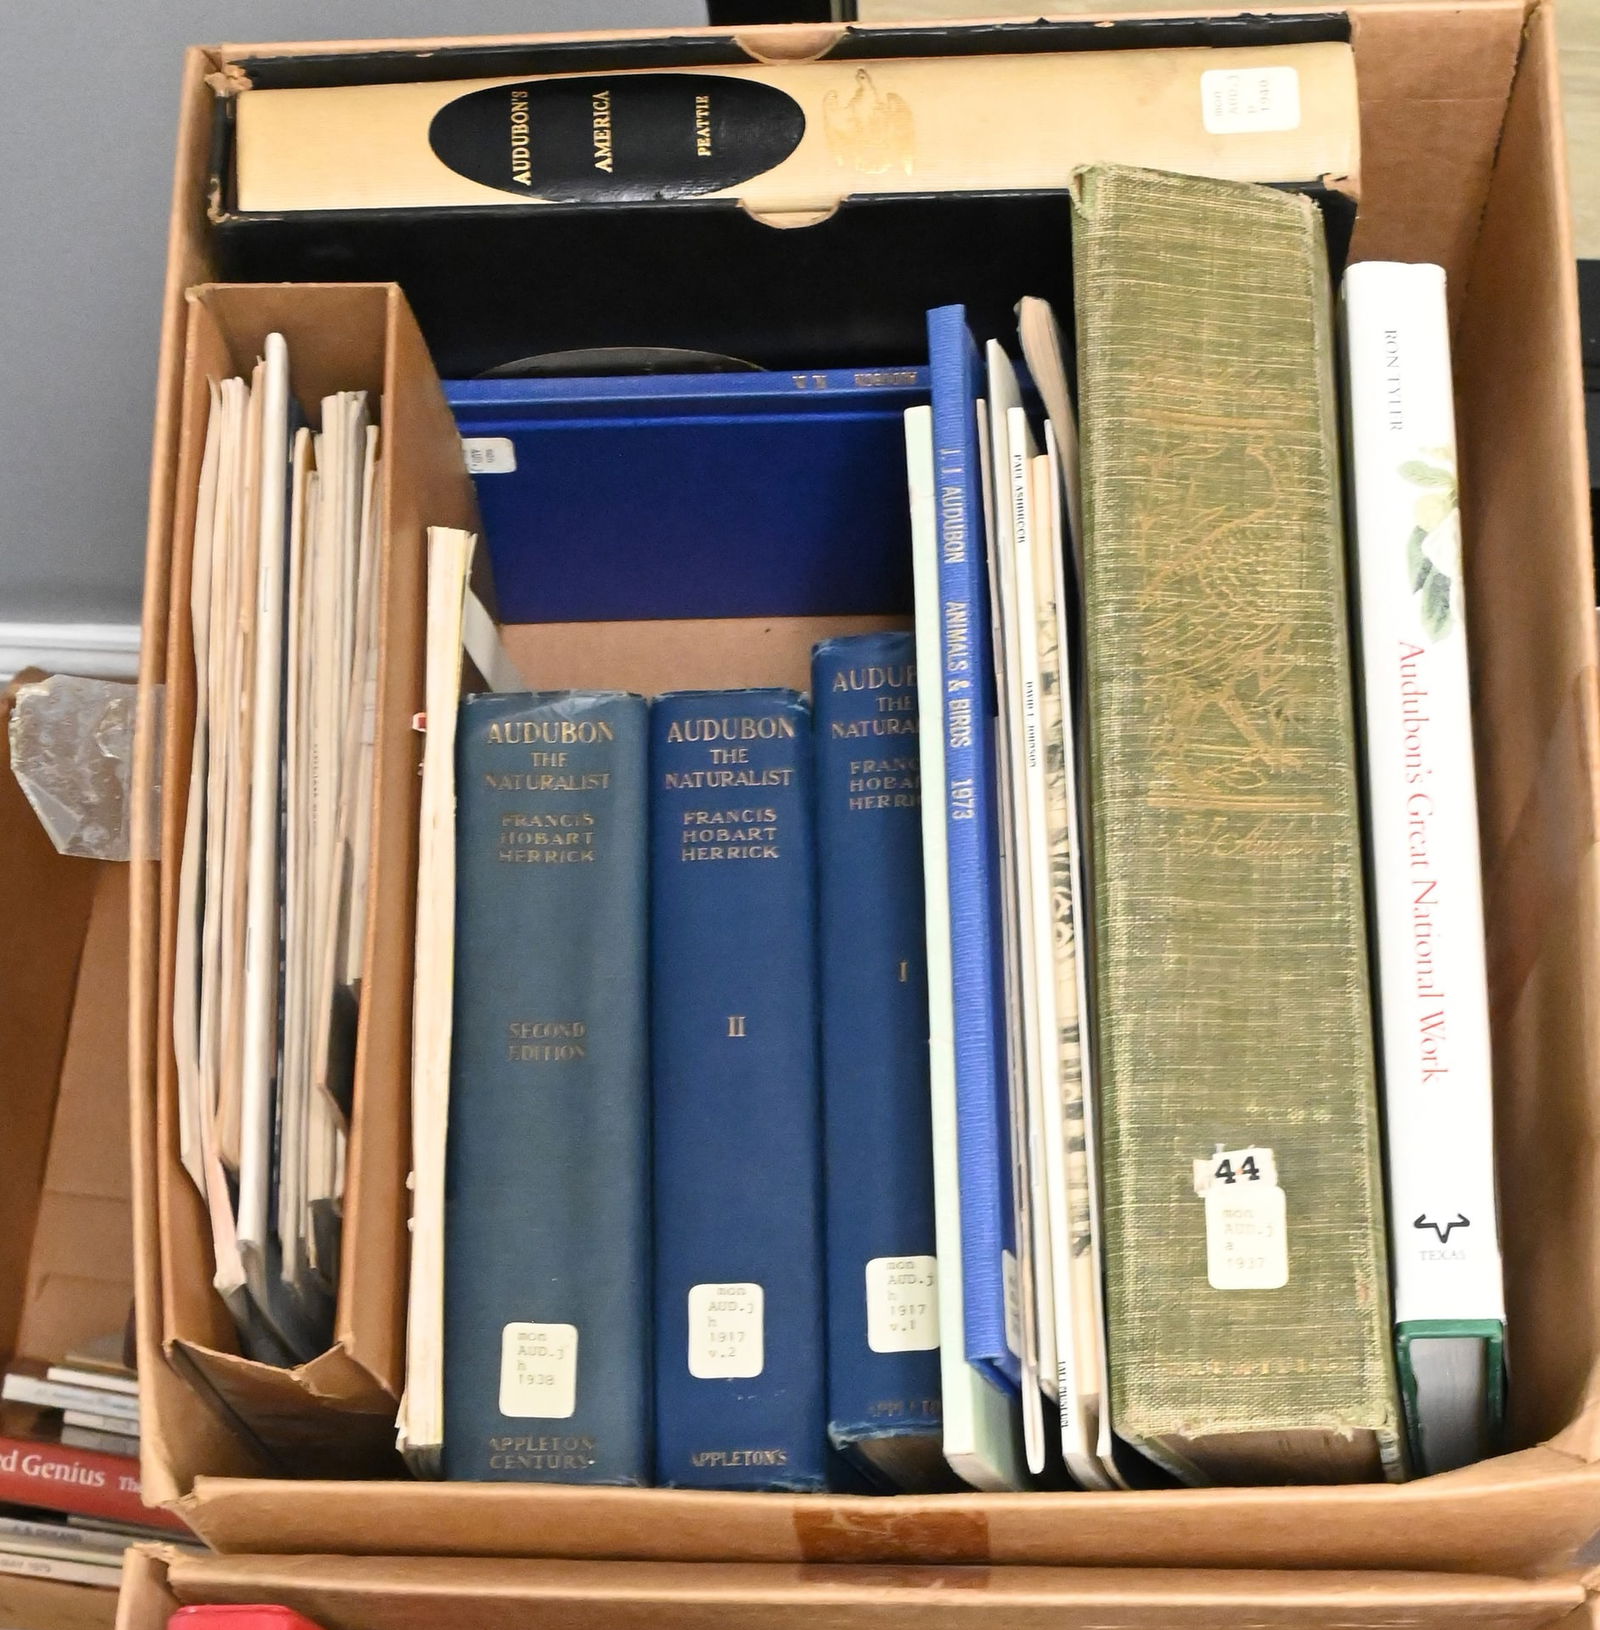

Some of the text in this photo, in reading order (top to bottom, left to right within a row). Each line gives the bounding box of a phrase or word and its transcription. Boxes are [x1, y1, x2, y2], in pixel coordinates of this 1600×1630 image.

[594, 90, 613, 174] AMERICA
[696, 95, 712, 157] PEATTIE
[512, 90, 533, 186] AUDUBON'S
[1386, 329, 1404, 432] RON TYLER
[941, 486, 964, 564] AUDUBON
[945, 600, 971, 748] ANIMALS & BIRDS
[876, 695, 913, 711] THE
[486, 721, 616, 745] AUDUBON
[667, 716, 796, 744] AUDUBON
[831, 717, 918, 740] NATURA
[530, 751, 569, 768] THE
[710, 748, 750, 765] THE
[849, 758, 918, 776] FRANC
[484, 772, 612, 793] NATURALIST
[664, 769, 794, 790] NATURALIST
[848, 776, 919, 793] HOBA
[848, 794, 920, 811] HERRI
[951, 778, 973, 821] 1973
[501, 812, 595, 829] FRANCIS
[683, 808, 777, 826] FRANCIS
[499, 830, 594, 847] HOBART
[682, 826, 778, 844] HOBART
[498, 847, 597, 864] HERRICK
[680, 845, 780, 863] HERRICK
[1396, 640, 1450, 1086] Audubon's Great National Work
[899, 961, 909, 983] I
[509, 1021, 587, 1040] SECOND
[727, 1016, 747, 1038] II
[507, 1044, 586, 1063] EDITION
[1214, 1155, 1261, 1185] 44
[1221, 1207, 1254, 1219] mon
[1419, 1250, 1467, 1262] TEXAS
[717, 1285, 747, 1296] mon
[888, 1303, 926, 1317] 1917
[708, 1315, 717, 1328] h
[517, 1331, 547, 1342] mon
[708, 1331, 746, 1345] 1917
[517, 1359, 526, 1372] h
[517, 1373, 555, 1386] 1938
[489, 1436, 595, 1454] APPLETON
[21, 1453, 106, 1488] Genius
[489, 1454, 590, 1471] CENTURY
